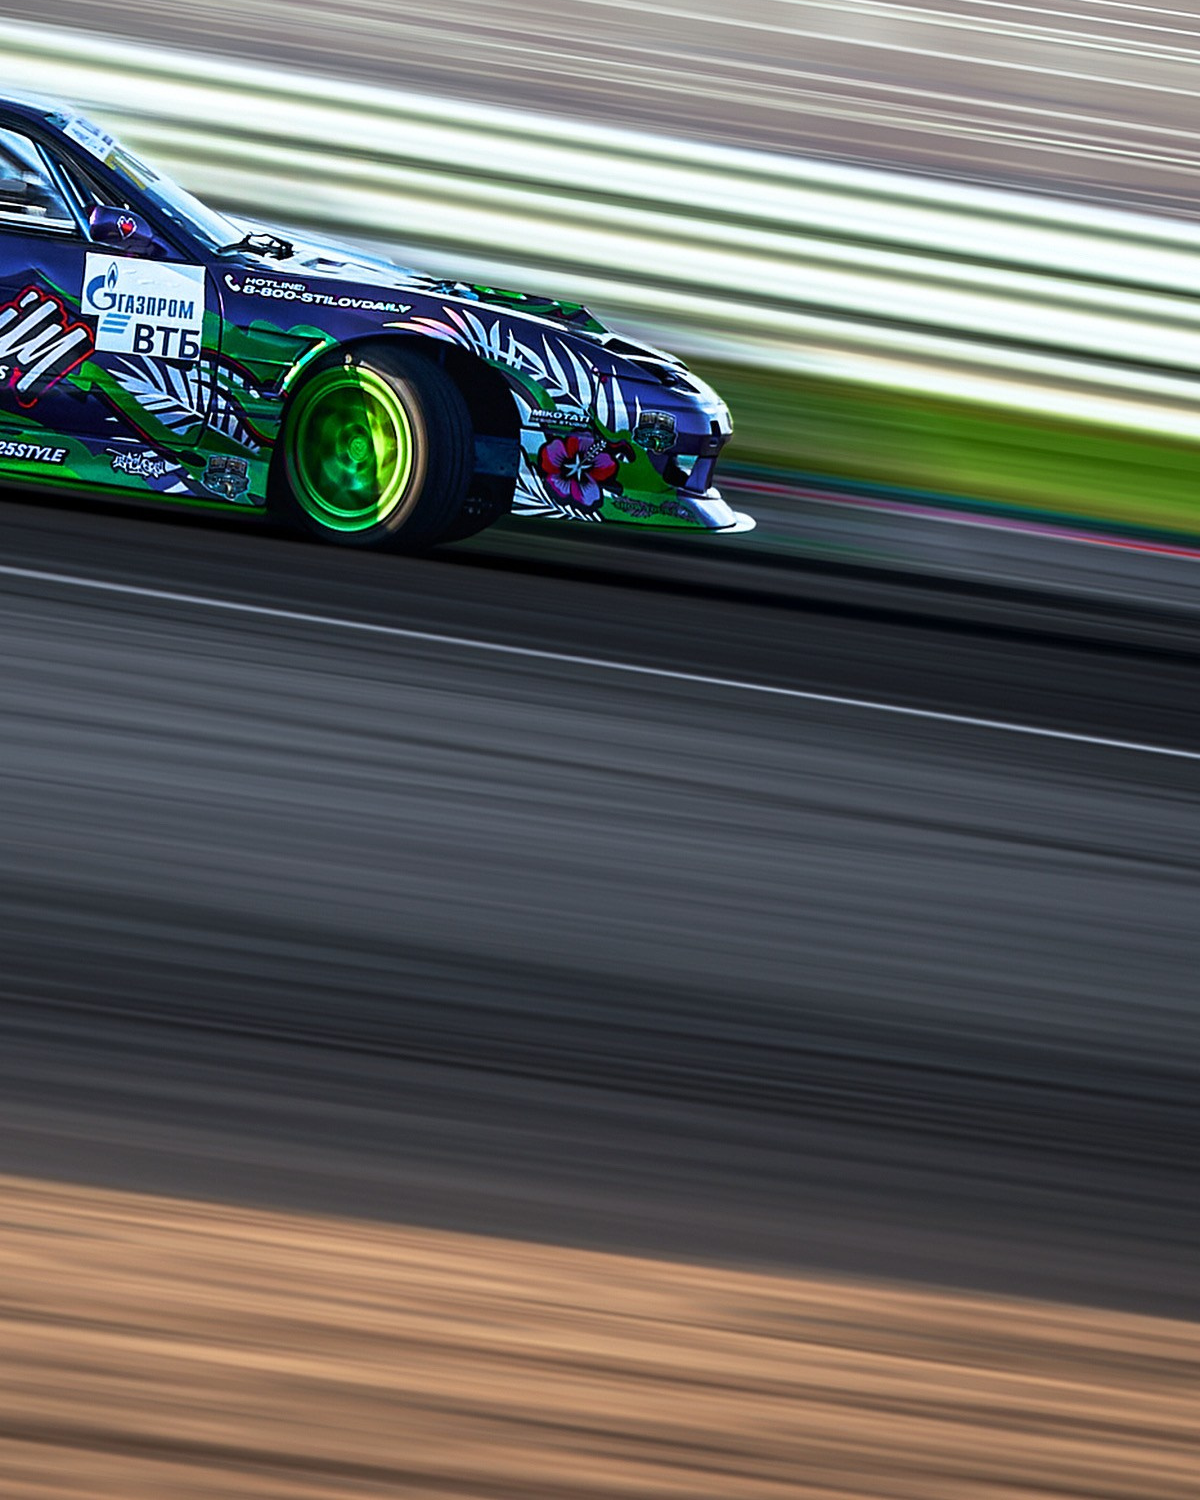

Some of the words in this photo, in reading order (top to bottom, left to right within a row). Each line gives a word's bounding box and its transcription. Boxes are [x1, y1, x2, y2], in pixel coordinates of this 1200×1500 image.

[245, 277, 305, 292] HOTLINE:
[118, 294, 194, 320] ГАЗПРОМ
[242, 285, 412, 314] 8-800-STILOVDAILY
[132, 323, 200, 359] ВТБ
